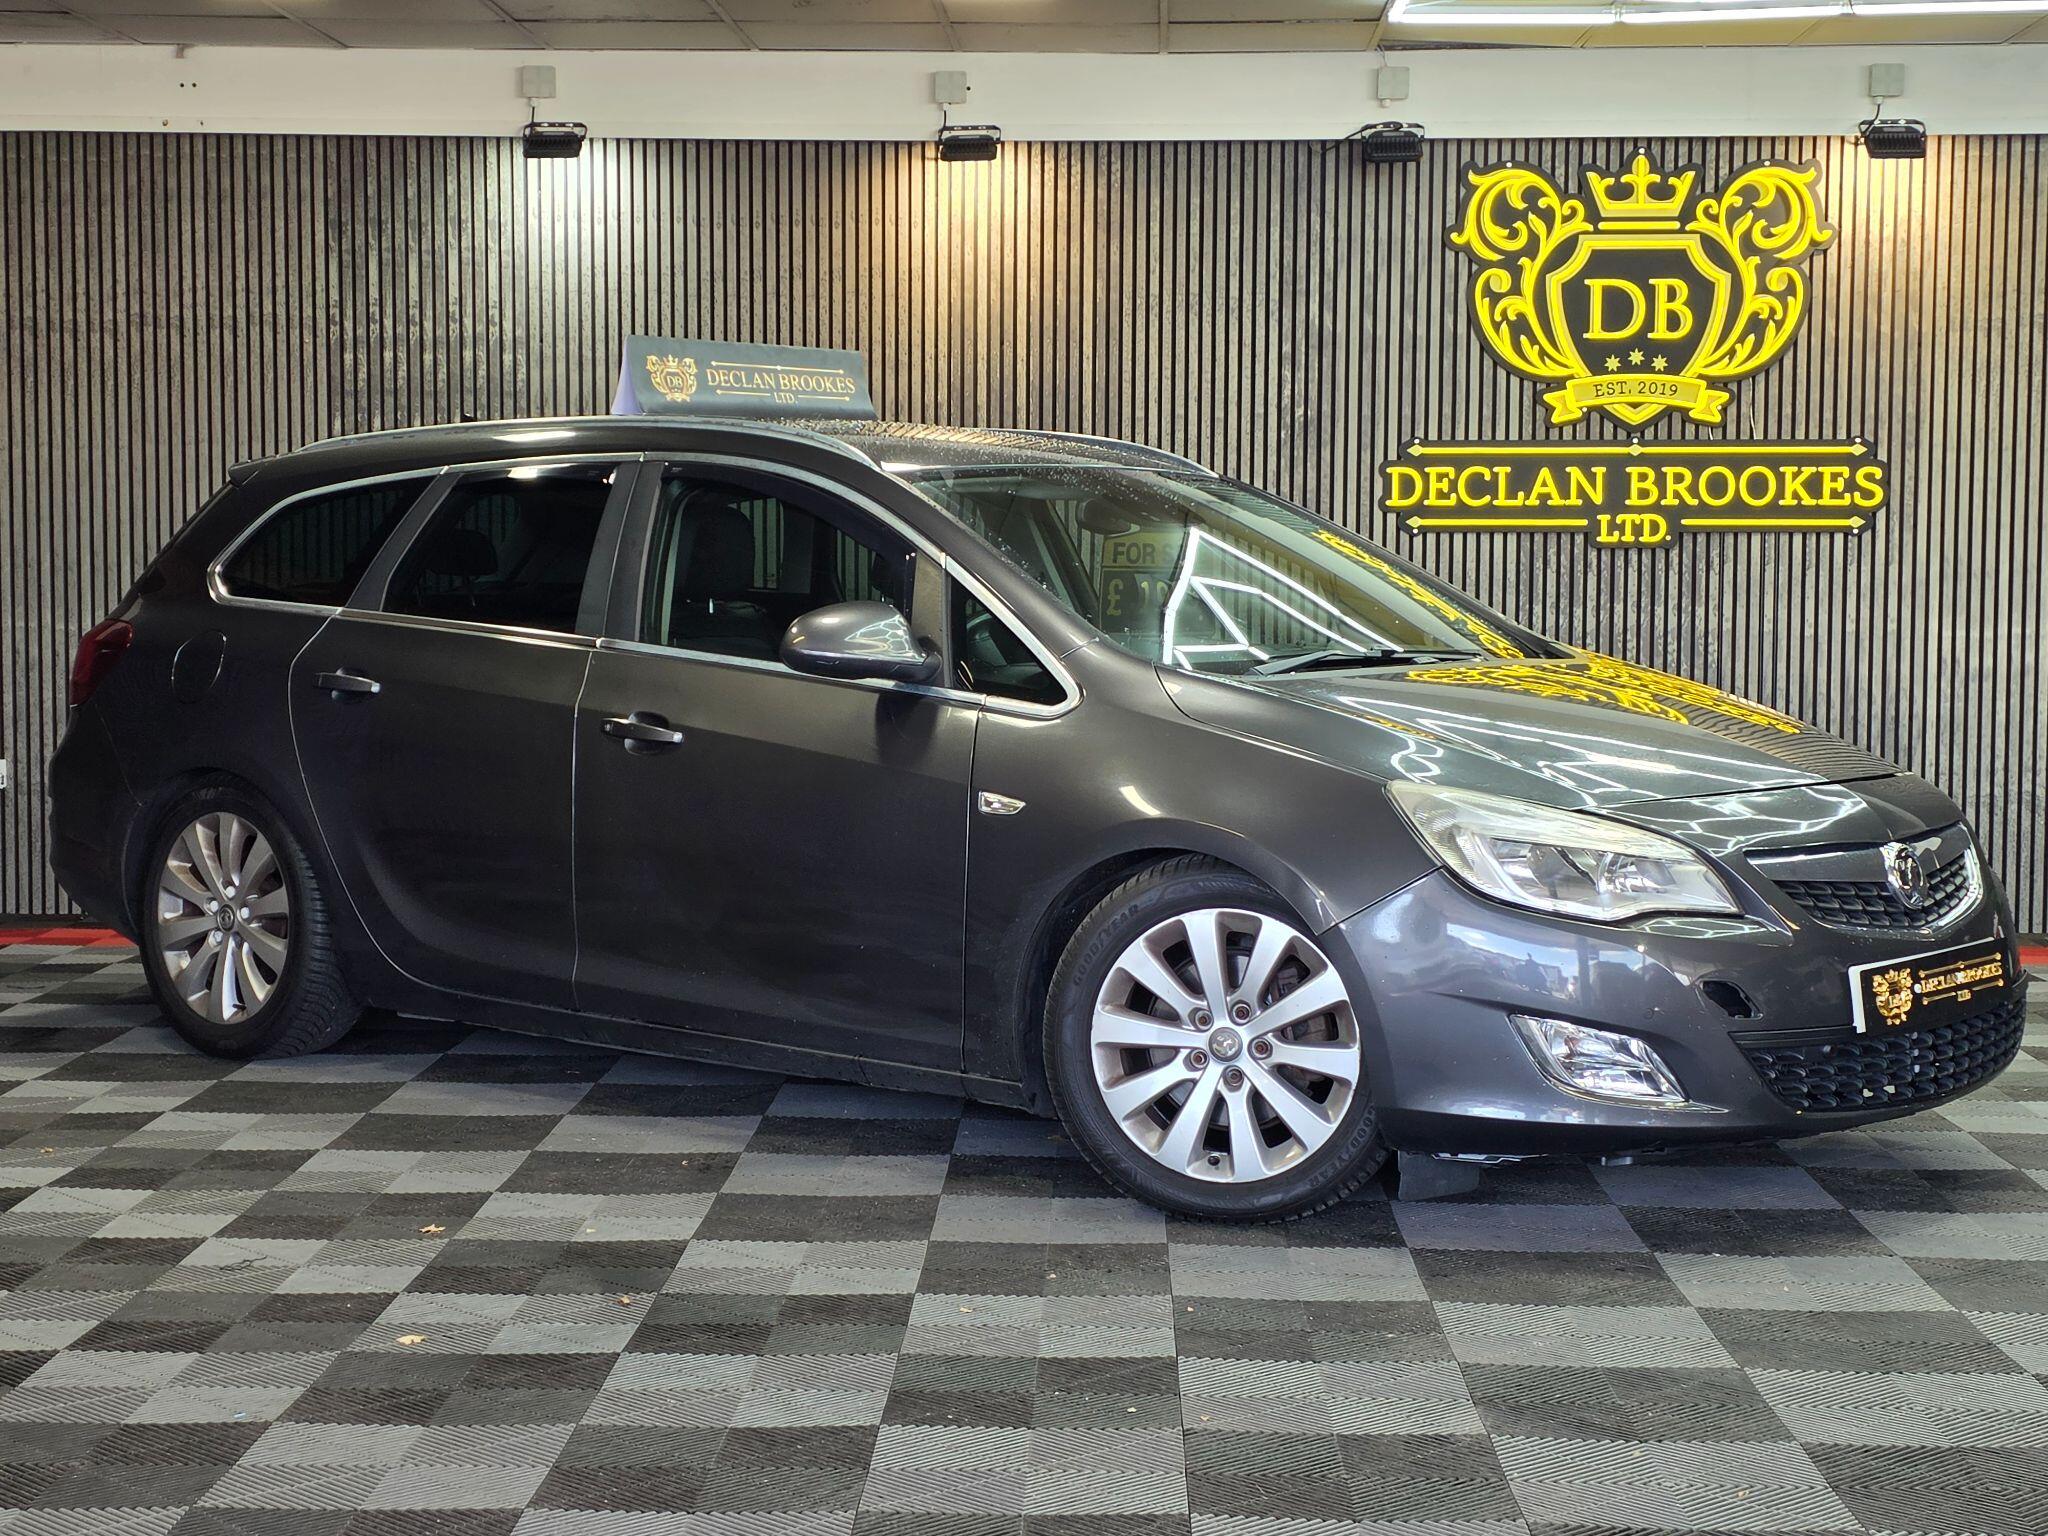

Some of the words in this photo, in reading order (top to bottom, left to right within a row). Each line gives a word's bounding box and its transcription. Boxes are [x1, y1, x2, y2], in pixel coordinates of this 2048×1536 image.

[1583, 278, 1694, 340] DB
[667, 375, 683, 388] DB
[706, 368, 776, 389] DECLAN
[778, 373, 856, 394] BROOKES
[1593, 381, 1632, 397] EST.
[1638, 381, 1678, 396] 2019
[774, 391, 798, 405] LTD.
[1386, 466, 1607, 507] DECLAN
[1624, 466, 1884, 507] BROOKES
[1596, 513, 1672, 543] LTD.
[1112, 542, 1156, 565] FOR
